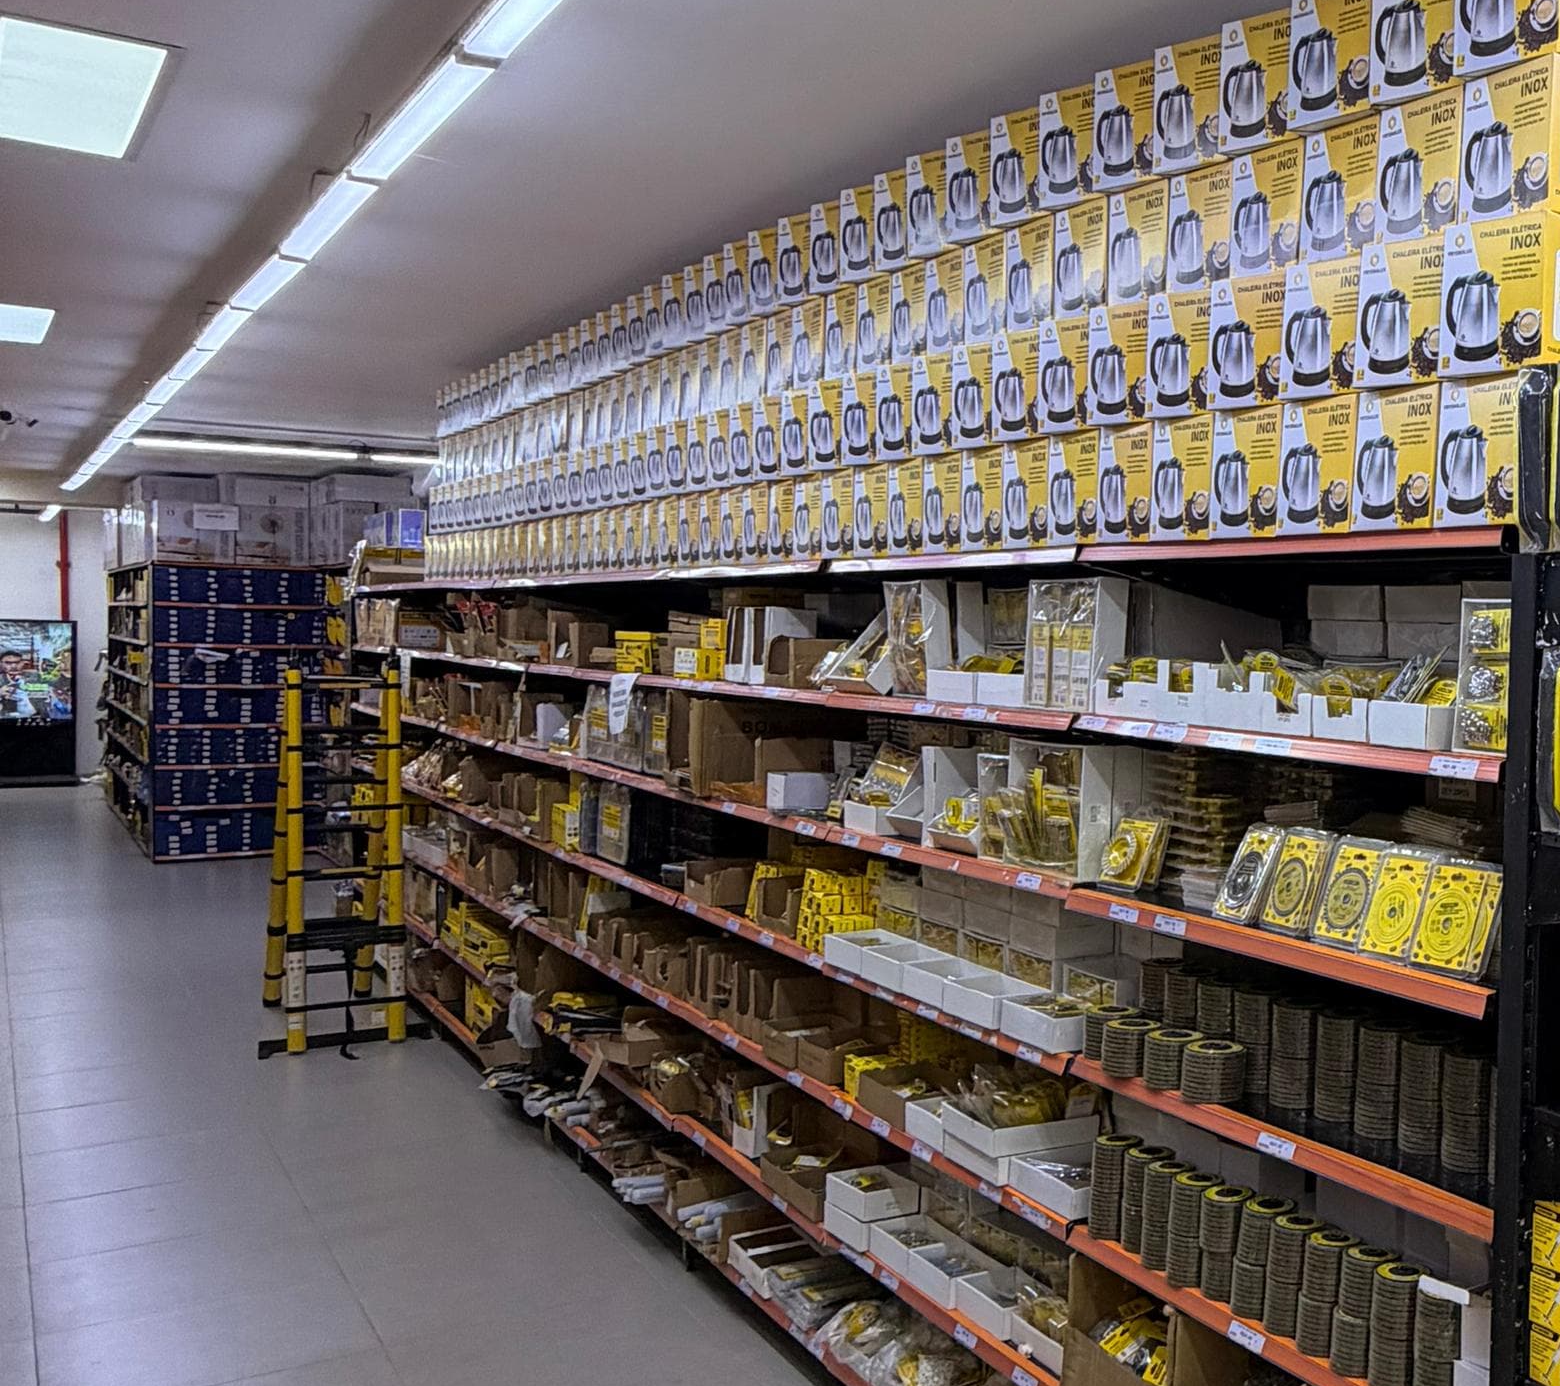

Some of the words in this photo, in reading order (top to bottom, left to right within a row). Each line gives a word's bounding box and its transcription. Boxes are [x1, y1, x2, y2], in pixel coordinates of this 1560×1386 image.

[1274, 26, 1291, 40] INO
[1520, 79, 1549, 97] INOX
[1432, 112, 1456, 127] INOX
[1353, 133, 1377, 149] INOX
[1277, 157, 1298, 170] INOX
[1209, 179, 1230, 191] INOX
[1510, 232, 1541, 251] INOX
[1340, 274, 1359, 288] INO
[1262, 289, 1285, 304] INOX
[1407, 403, 1432, 417] INOX
[1328, 413, 1350, 427] INOX
[1256, 421, 1277, 435] INOX
[1190, 430, 1209, 442] INOX
